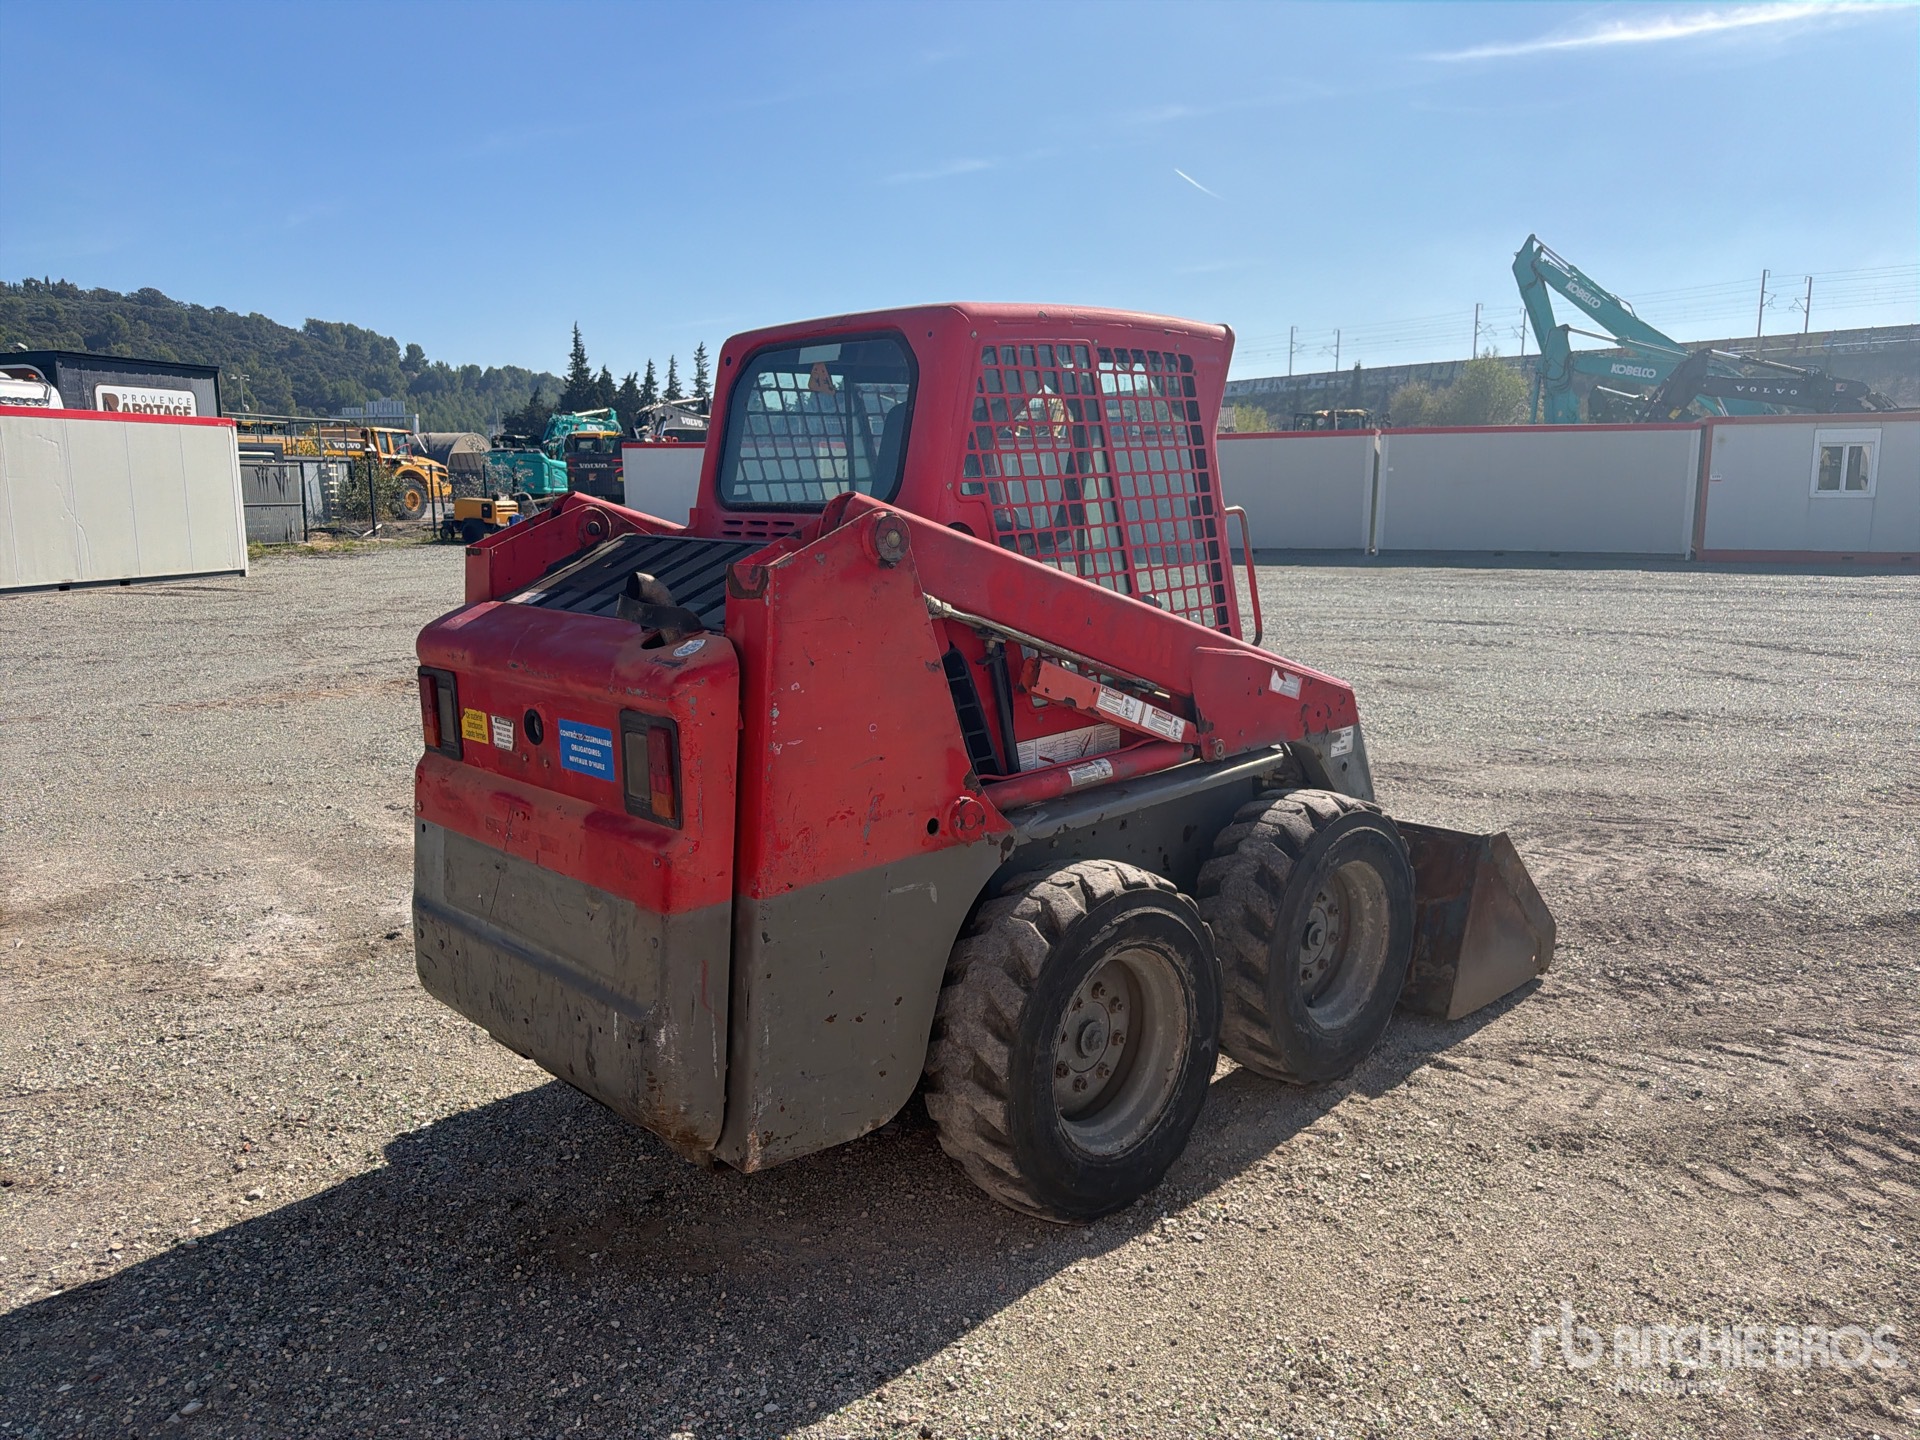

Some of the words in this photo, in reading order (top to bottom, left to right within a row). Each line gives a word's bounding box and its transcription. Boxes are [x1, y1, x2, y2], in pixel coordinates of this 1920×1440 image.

[1565, 280, 1602, 310] KOBELCO
[1610, 362, 1657, 379] KOBELCO
[1735, 385, 1799, 396] VOLVO
[122, 393, 192, 406] PROVENCE
[680, 416, 704, 428] VOLVO
[333, 441, 361, 450] VOLVO
[569, 755, 588, 766] NIVEAUX
[588, 760, 606, 771] D'HUILE
